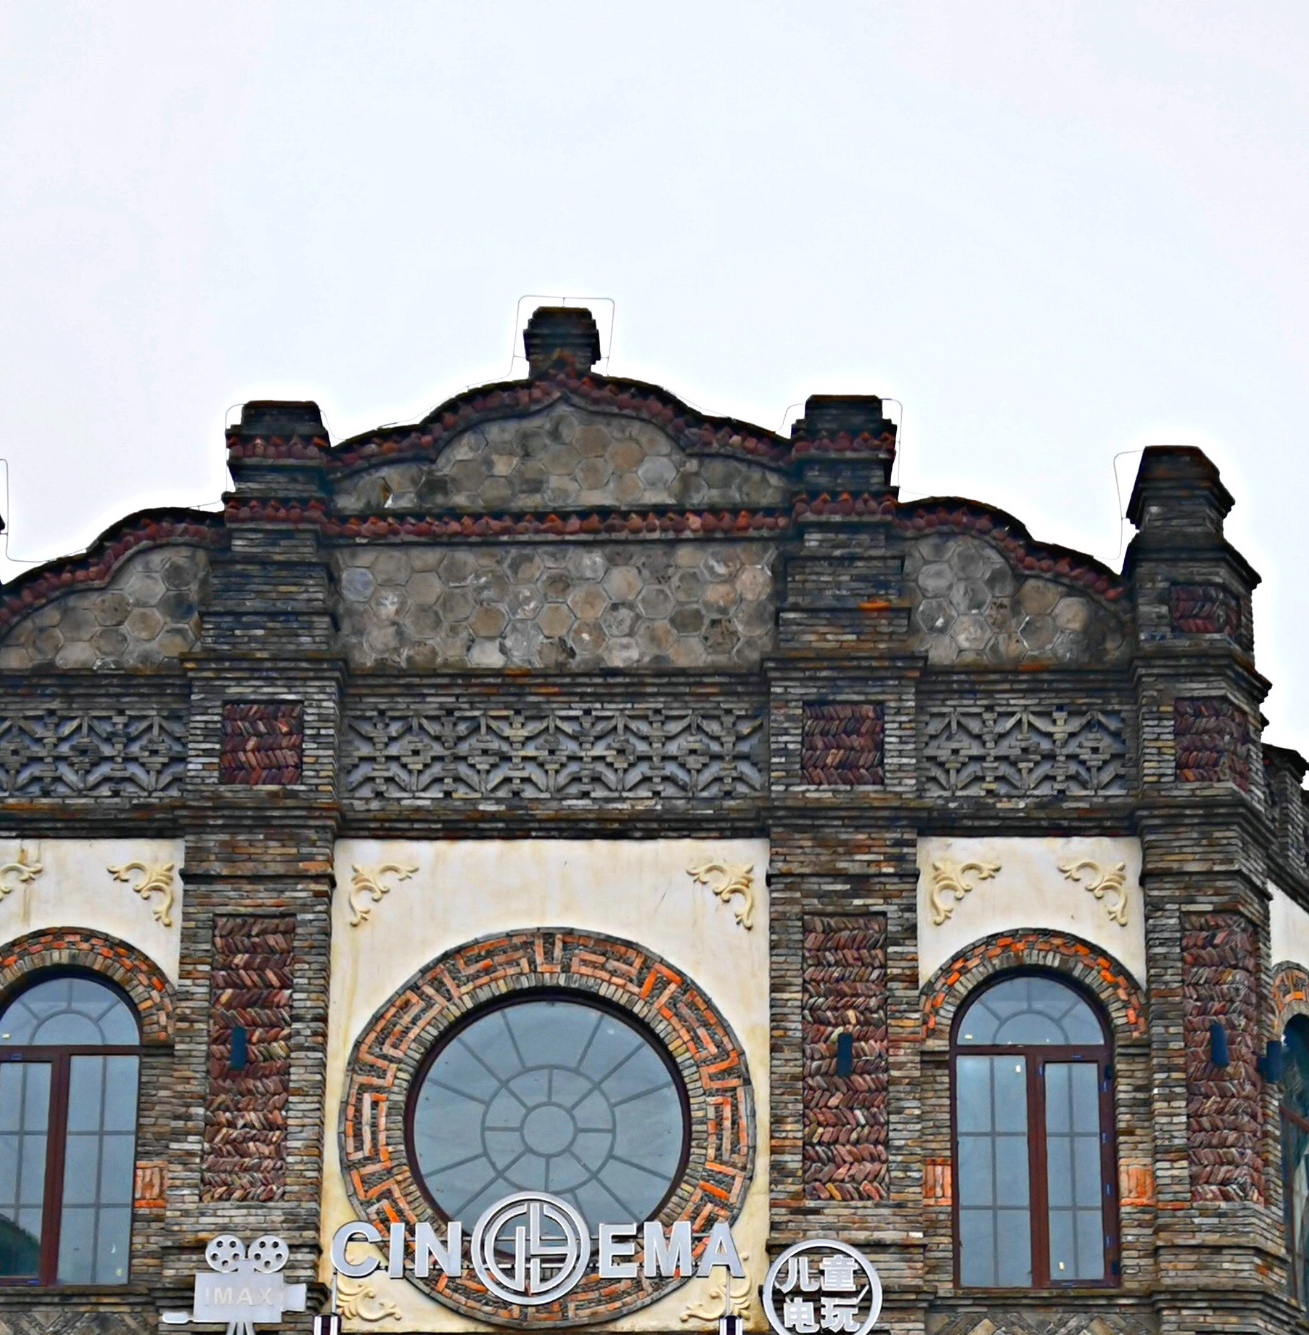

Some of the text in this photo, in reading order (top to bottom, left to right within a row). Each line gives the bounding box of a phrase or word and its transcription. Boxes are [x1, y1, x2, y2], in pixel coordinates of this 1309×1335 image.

[774, 1254, 859, 1294] 儿童
[204, 1286, 274, 1307] IMAX
[782, 1296, 861, 1334] 电玩
